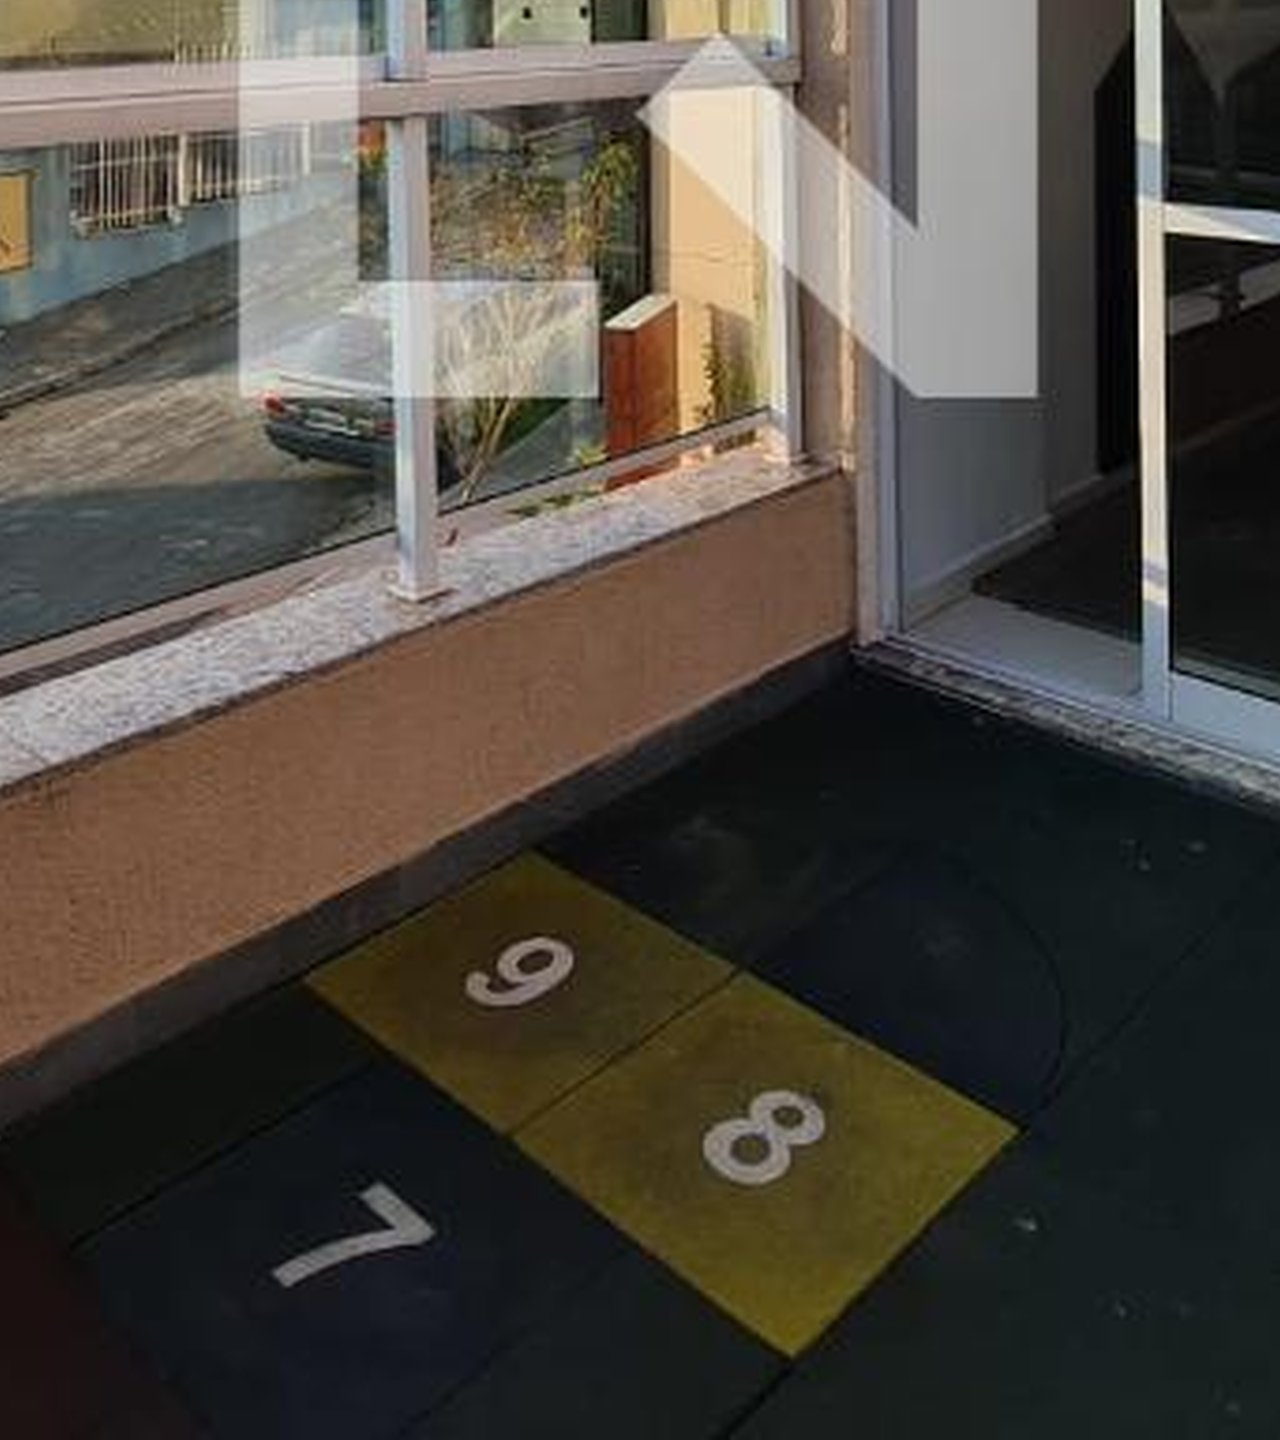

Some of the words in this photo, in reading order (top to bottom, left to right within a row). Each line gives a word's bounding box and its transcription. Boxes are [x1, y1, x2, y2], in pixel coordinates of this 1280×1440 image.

[466, 936, 575, 1008] 9
[702, 1089, 826, 1185] 8
[272, 1182, 436, 1288] 7
